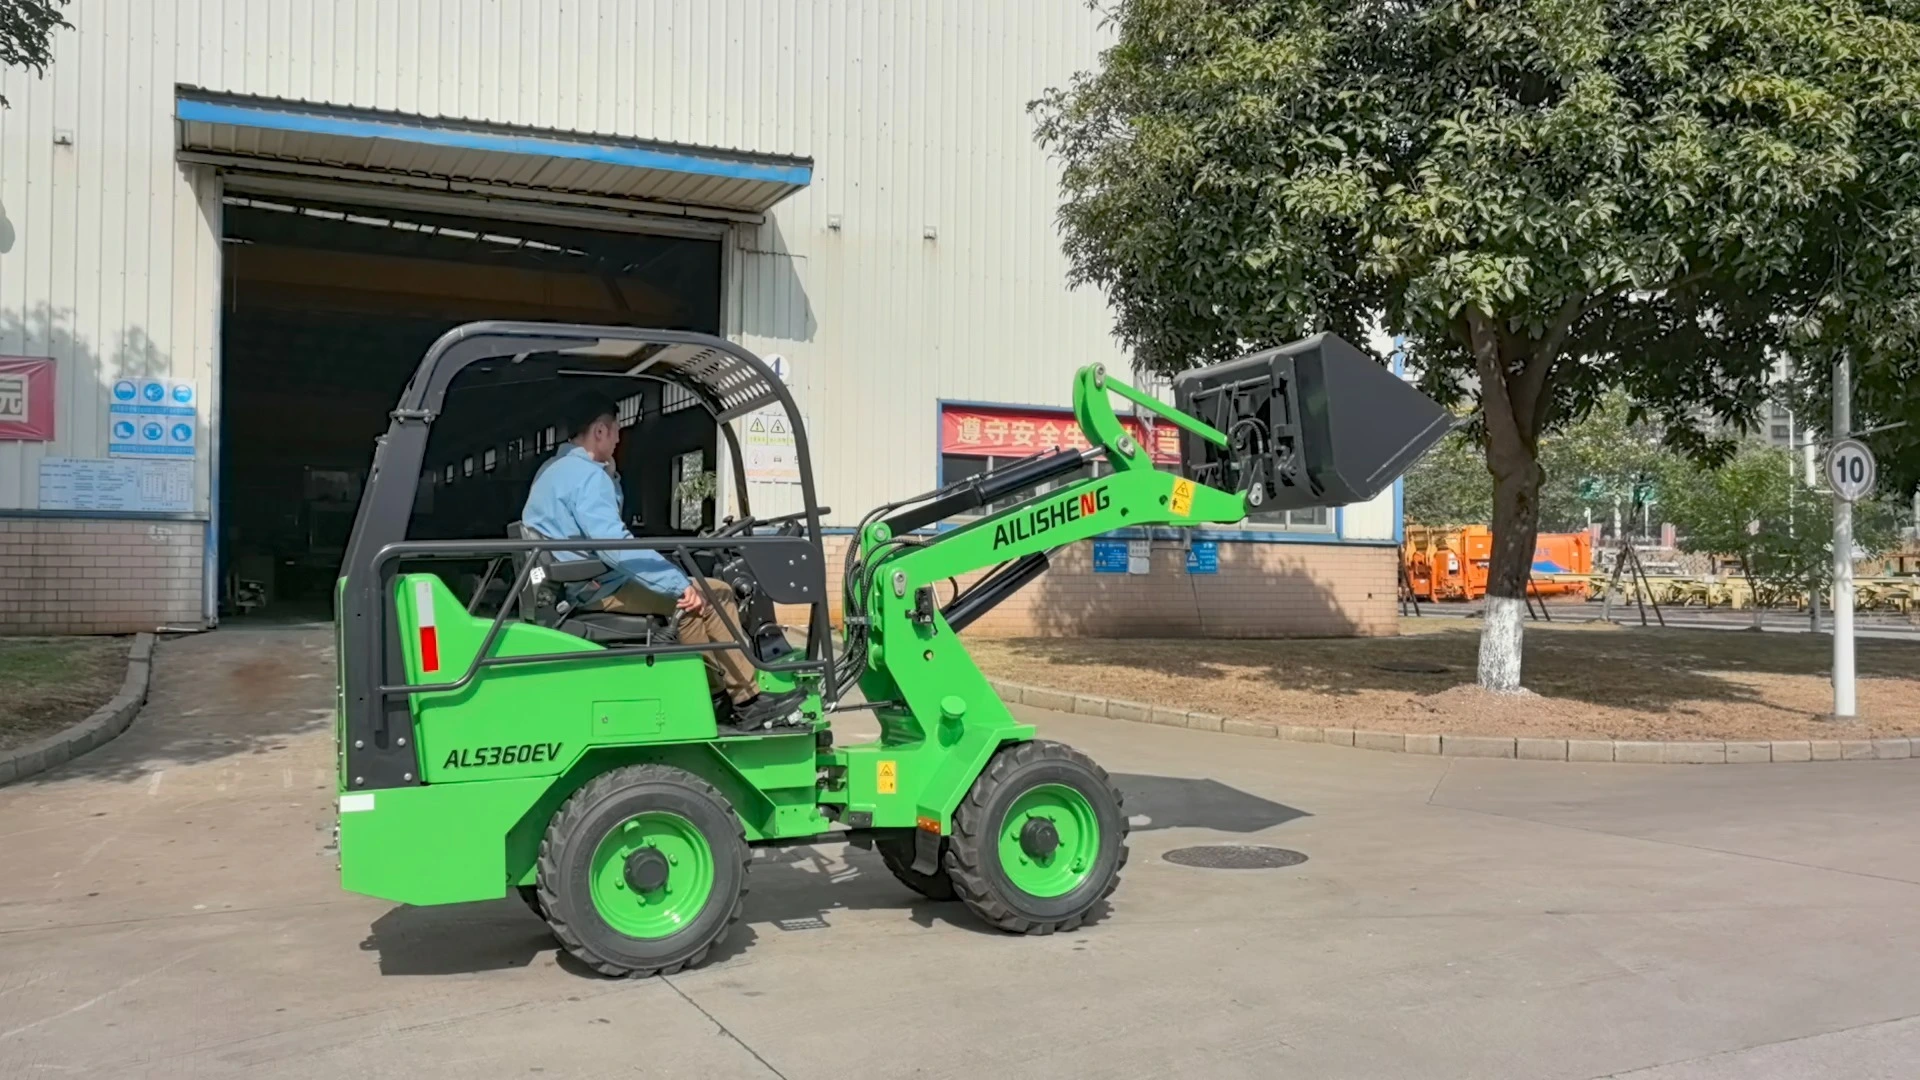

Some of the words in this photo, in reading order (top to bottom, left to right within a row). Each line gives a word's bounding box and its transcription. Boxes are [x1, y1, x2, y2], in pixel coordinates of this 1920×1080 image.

[957, 417, 1133, 450] 遵守安全生
[1836, 455, 1865, 484] 10
[993, 485, 1110, 550] AILISHENG
[443, 742, 563, 769] ALS360EV
